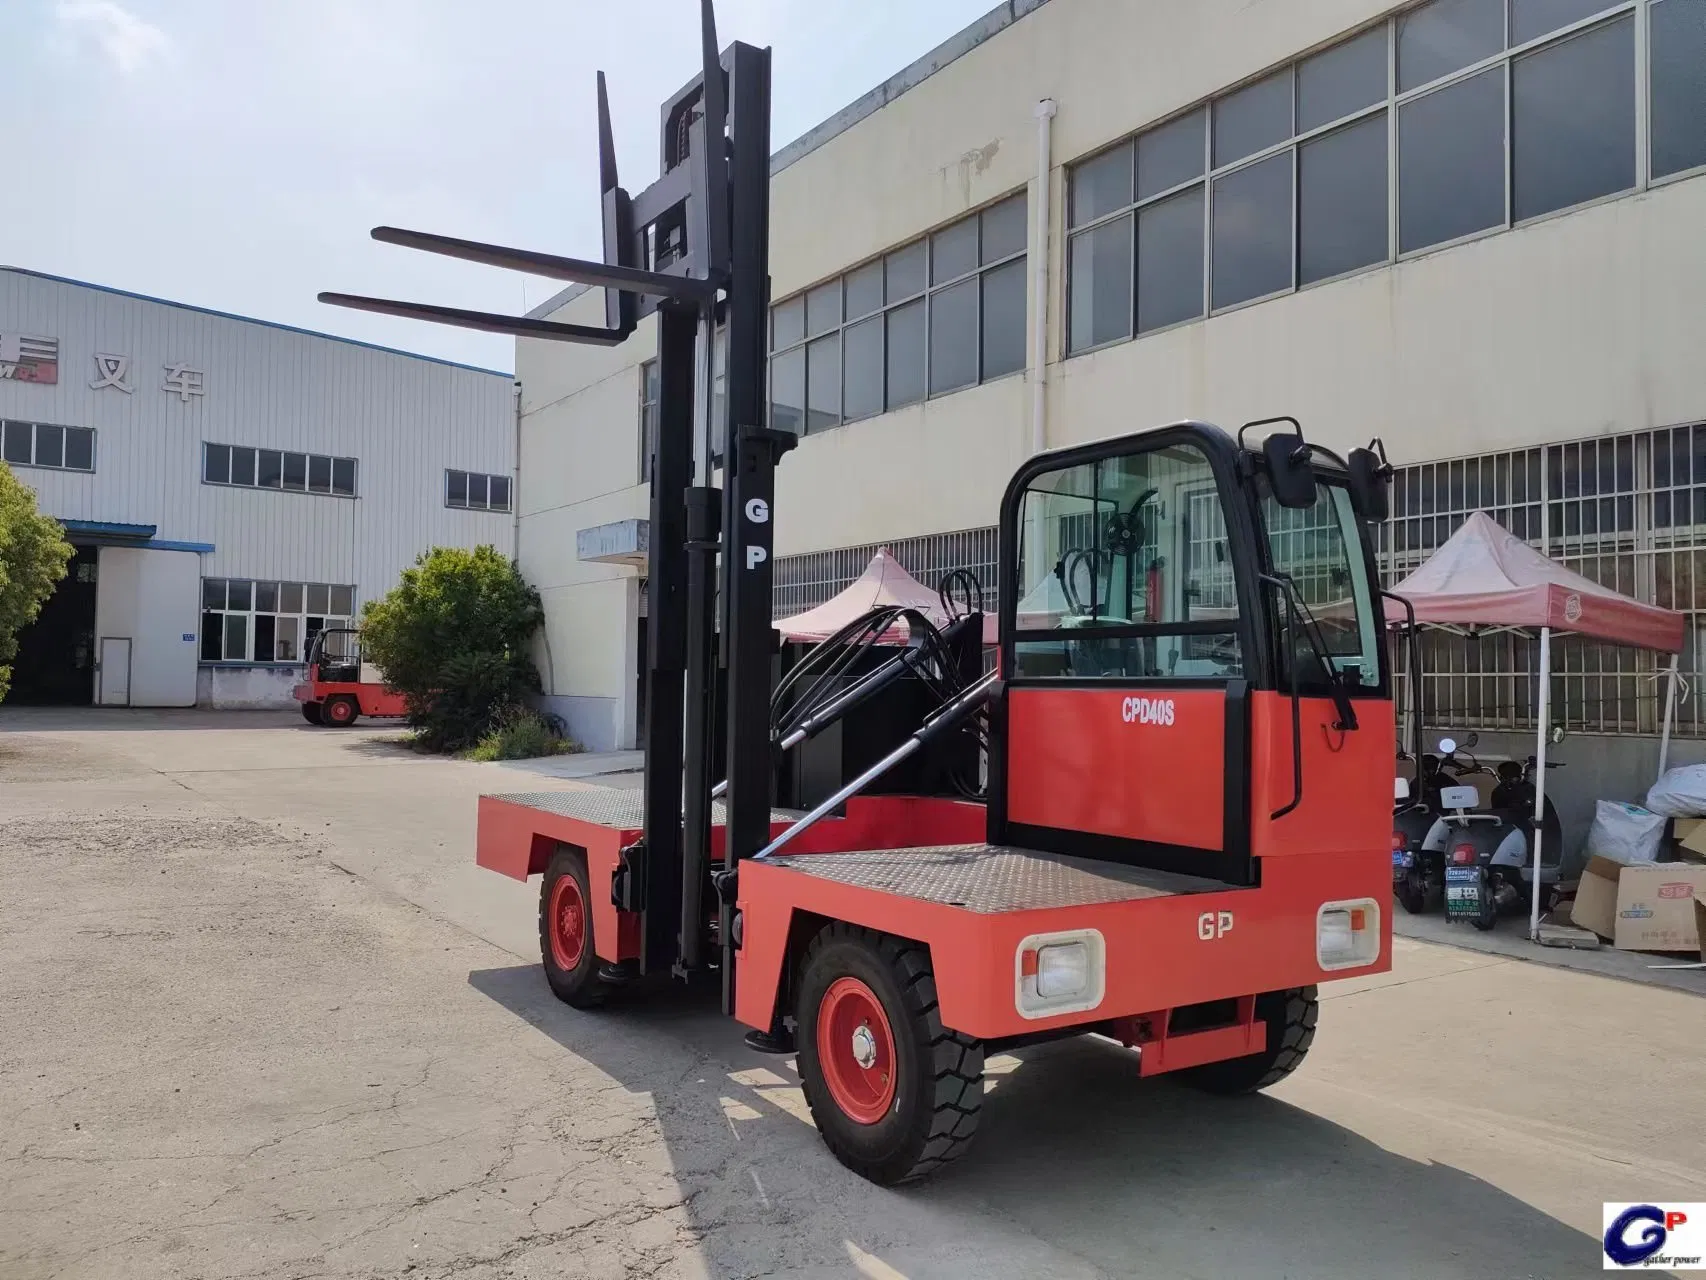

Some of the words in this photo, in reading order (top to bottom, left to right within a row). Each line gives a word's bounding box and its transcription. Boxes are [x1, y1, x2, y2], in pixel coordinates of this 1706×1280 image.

[88, 352, 206, 403] 叉车
[1122, 696, 1175, 726] CPD40S
[1198, 911, 1234, 940] GP
